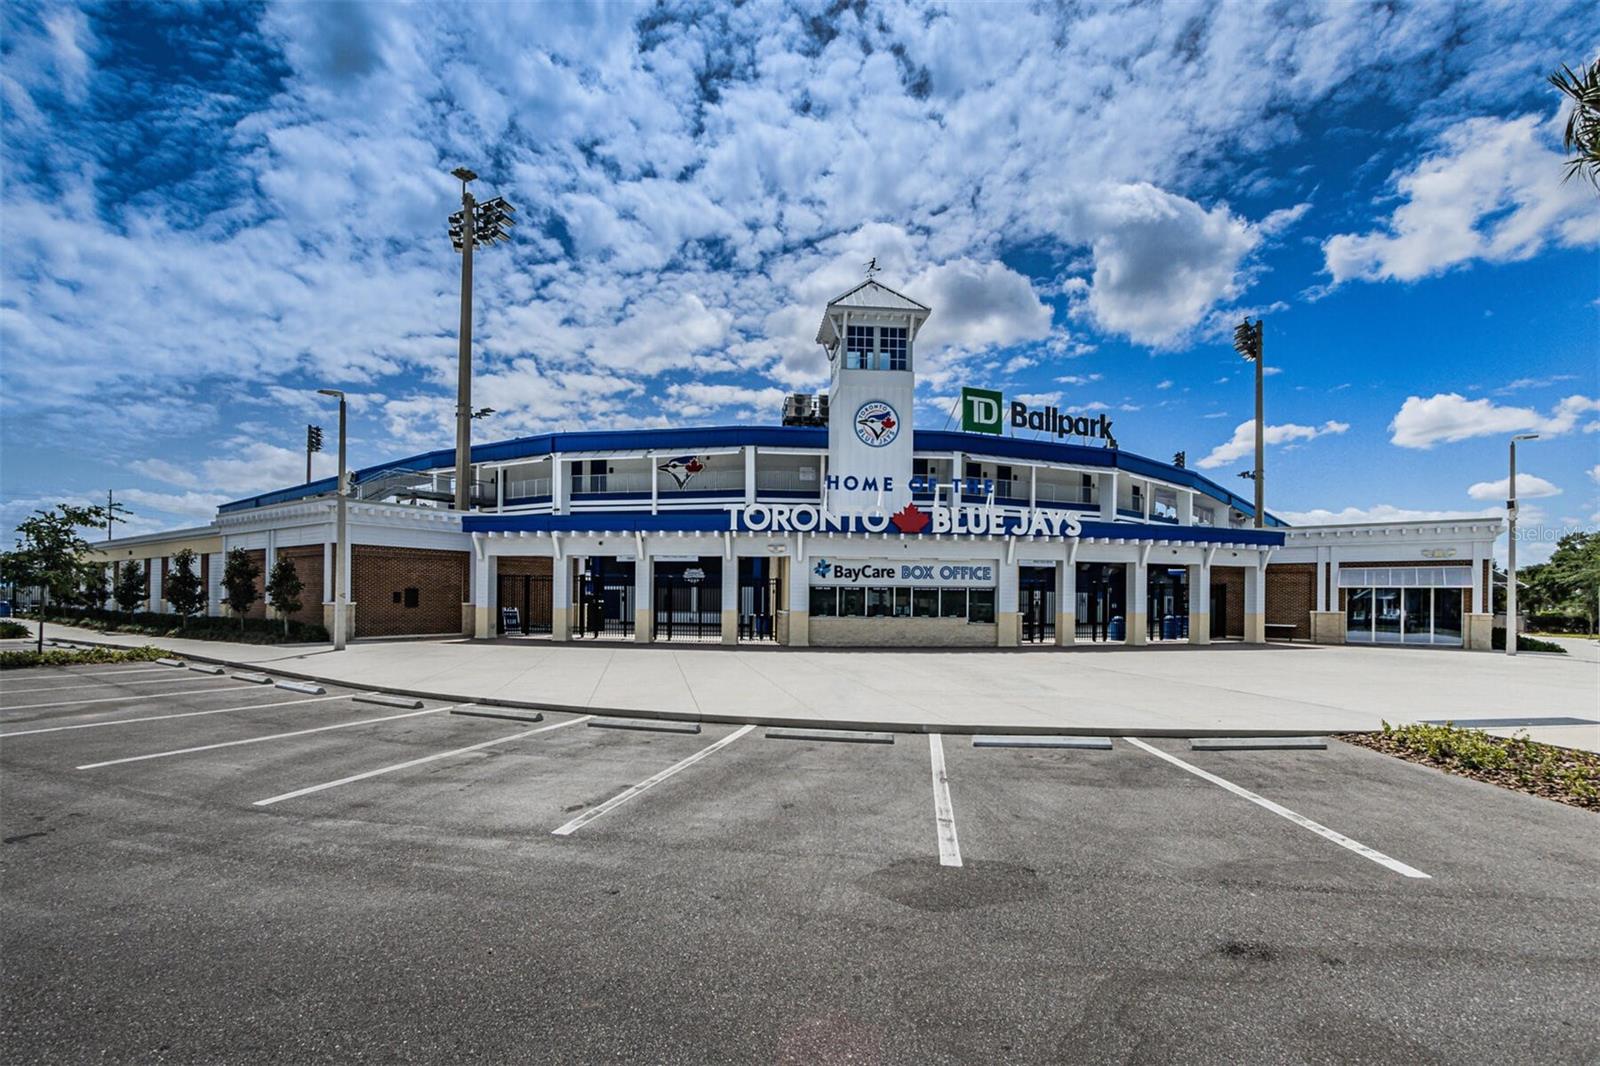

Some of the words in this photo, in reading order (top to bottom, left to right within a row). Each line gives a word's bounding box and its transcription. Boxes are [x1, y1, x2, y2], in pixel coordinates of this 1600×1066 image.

[858, 404, 888, 419] TORONTO
[966, 395, 998, 425] TD
[1011, 401, 1114, 440] Ballpark
[858, 428, 875, 444] BLUE
[879, 430, 895, 445] JAYS
[827, 475, 893, 491] HOME
[909, 478, 937, 493] OF
[952, 479, 994, 494] THE
[723, 503, 890, 532] TORONTO
[932, 506, 1006, 534] BLUE
[1011, 508, 1081, 537] JAYS
[834, 565, 895, 582] BayCare
[901, 565, 934, 580] BOX
[939, 565, 992, 581] OFFICE
